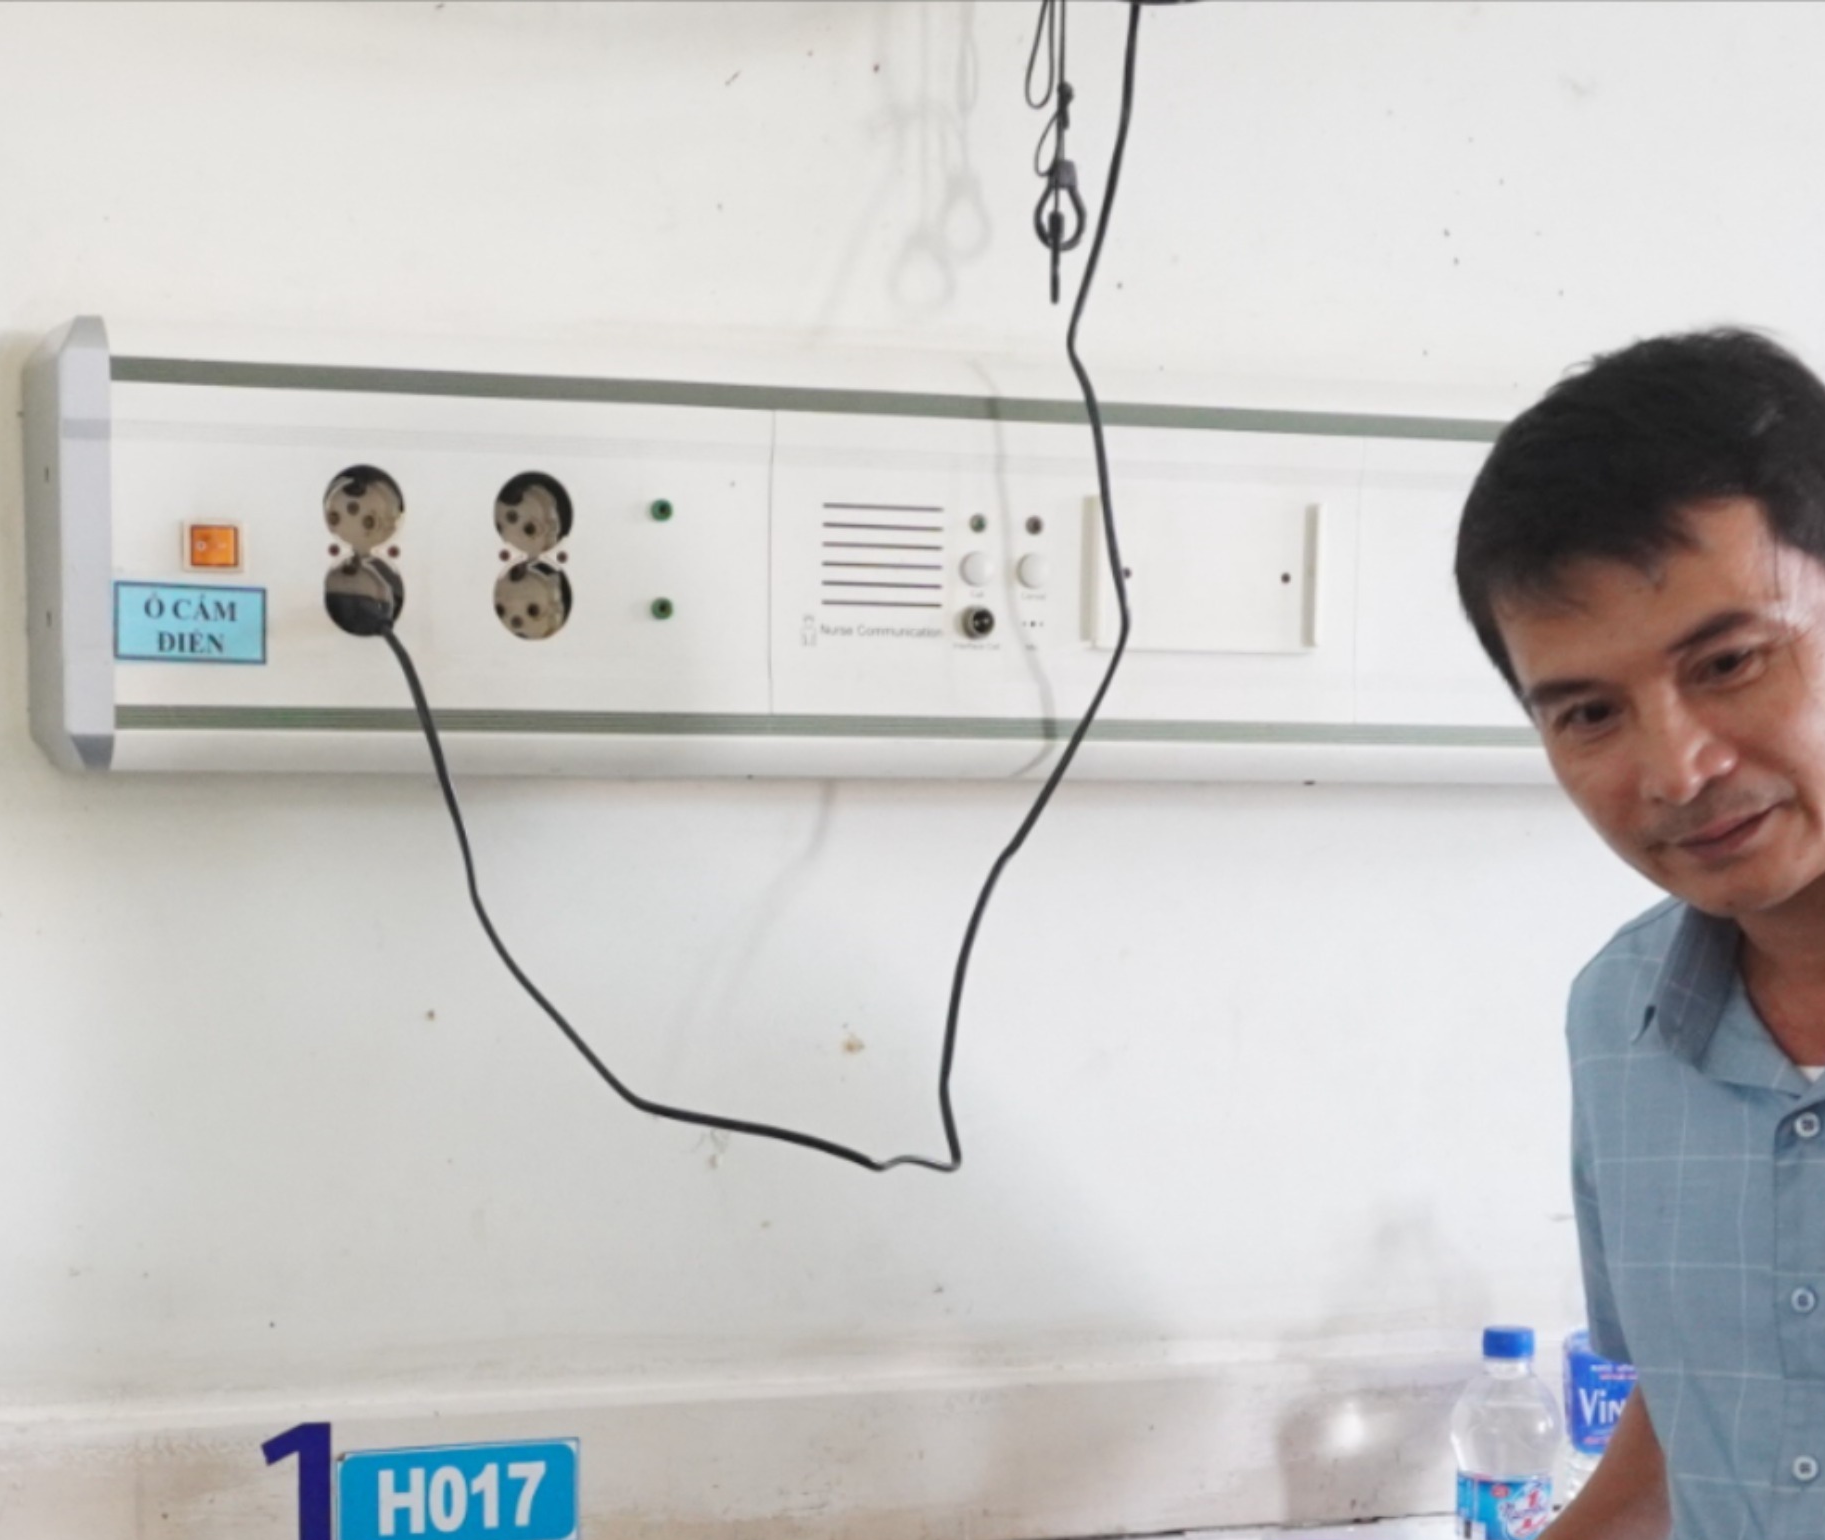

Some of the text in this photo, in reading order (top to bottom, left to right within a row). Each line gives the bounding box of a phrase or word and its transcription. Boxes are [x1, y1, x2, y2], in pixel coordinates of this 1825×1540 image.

[821, 624, 942, 638] Nurse Communication
[378, 1461, 547, 1536] H017
